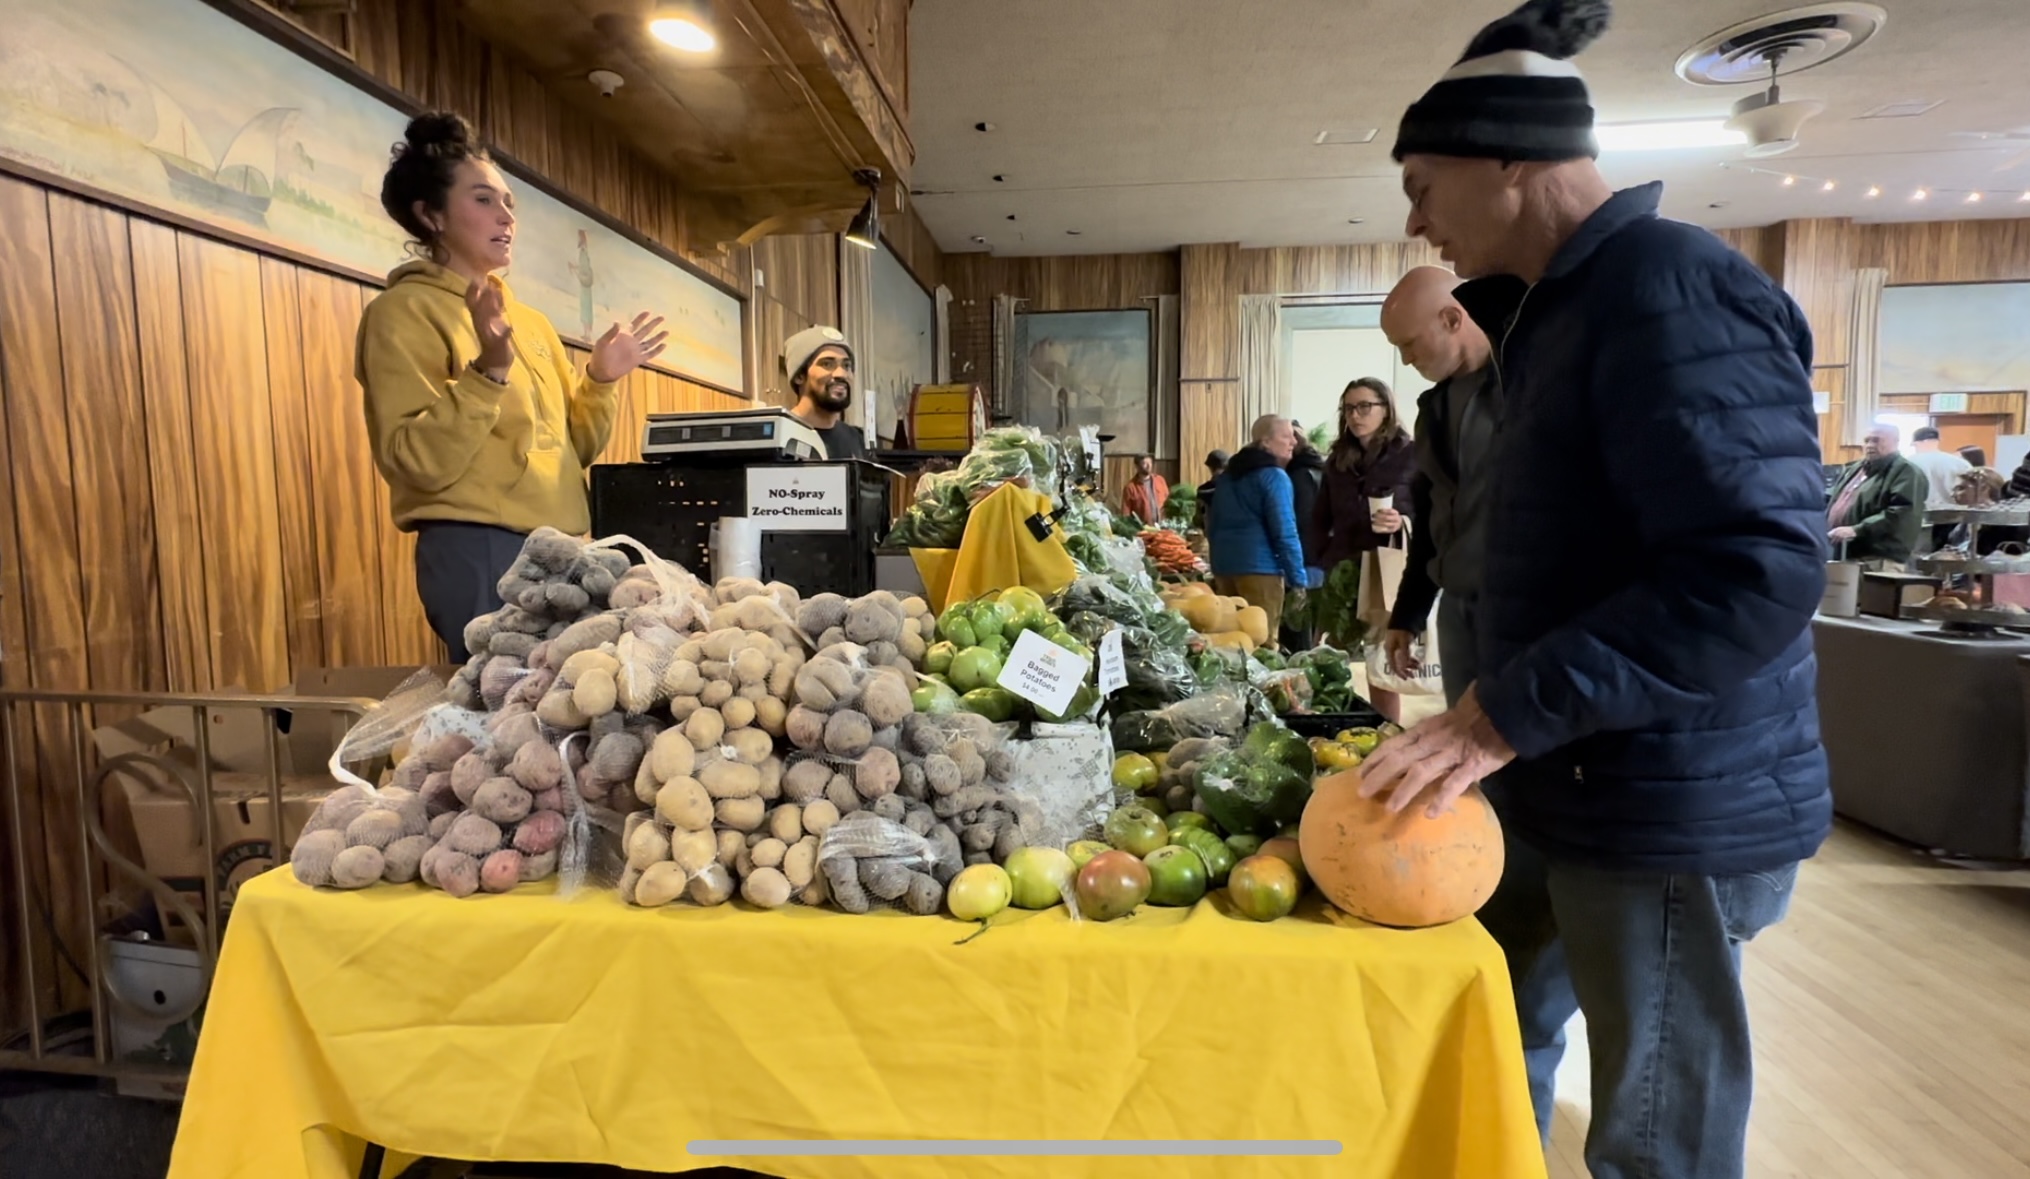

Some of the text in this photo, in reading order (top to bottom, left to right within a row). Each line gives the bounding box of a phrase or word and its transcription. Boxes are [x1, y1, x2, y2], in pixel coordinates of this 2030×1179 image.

[769, 489, 825, 500] NO-Spray
[752, 506, 843, 516] Zero-Chemicals
[1027, 660, 1060, 682] Bagged
[1384, 663, 1442, 678] ONIC
[1020, 669, 1057, 692] Potatoes
